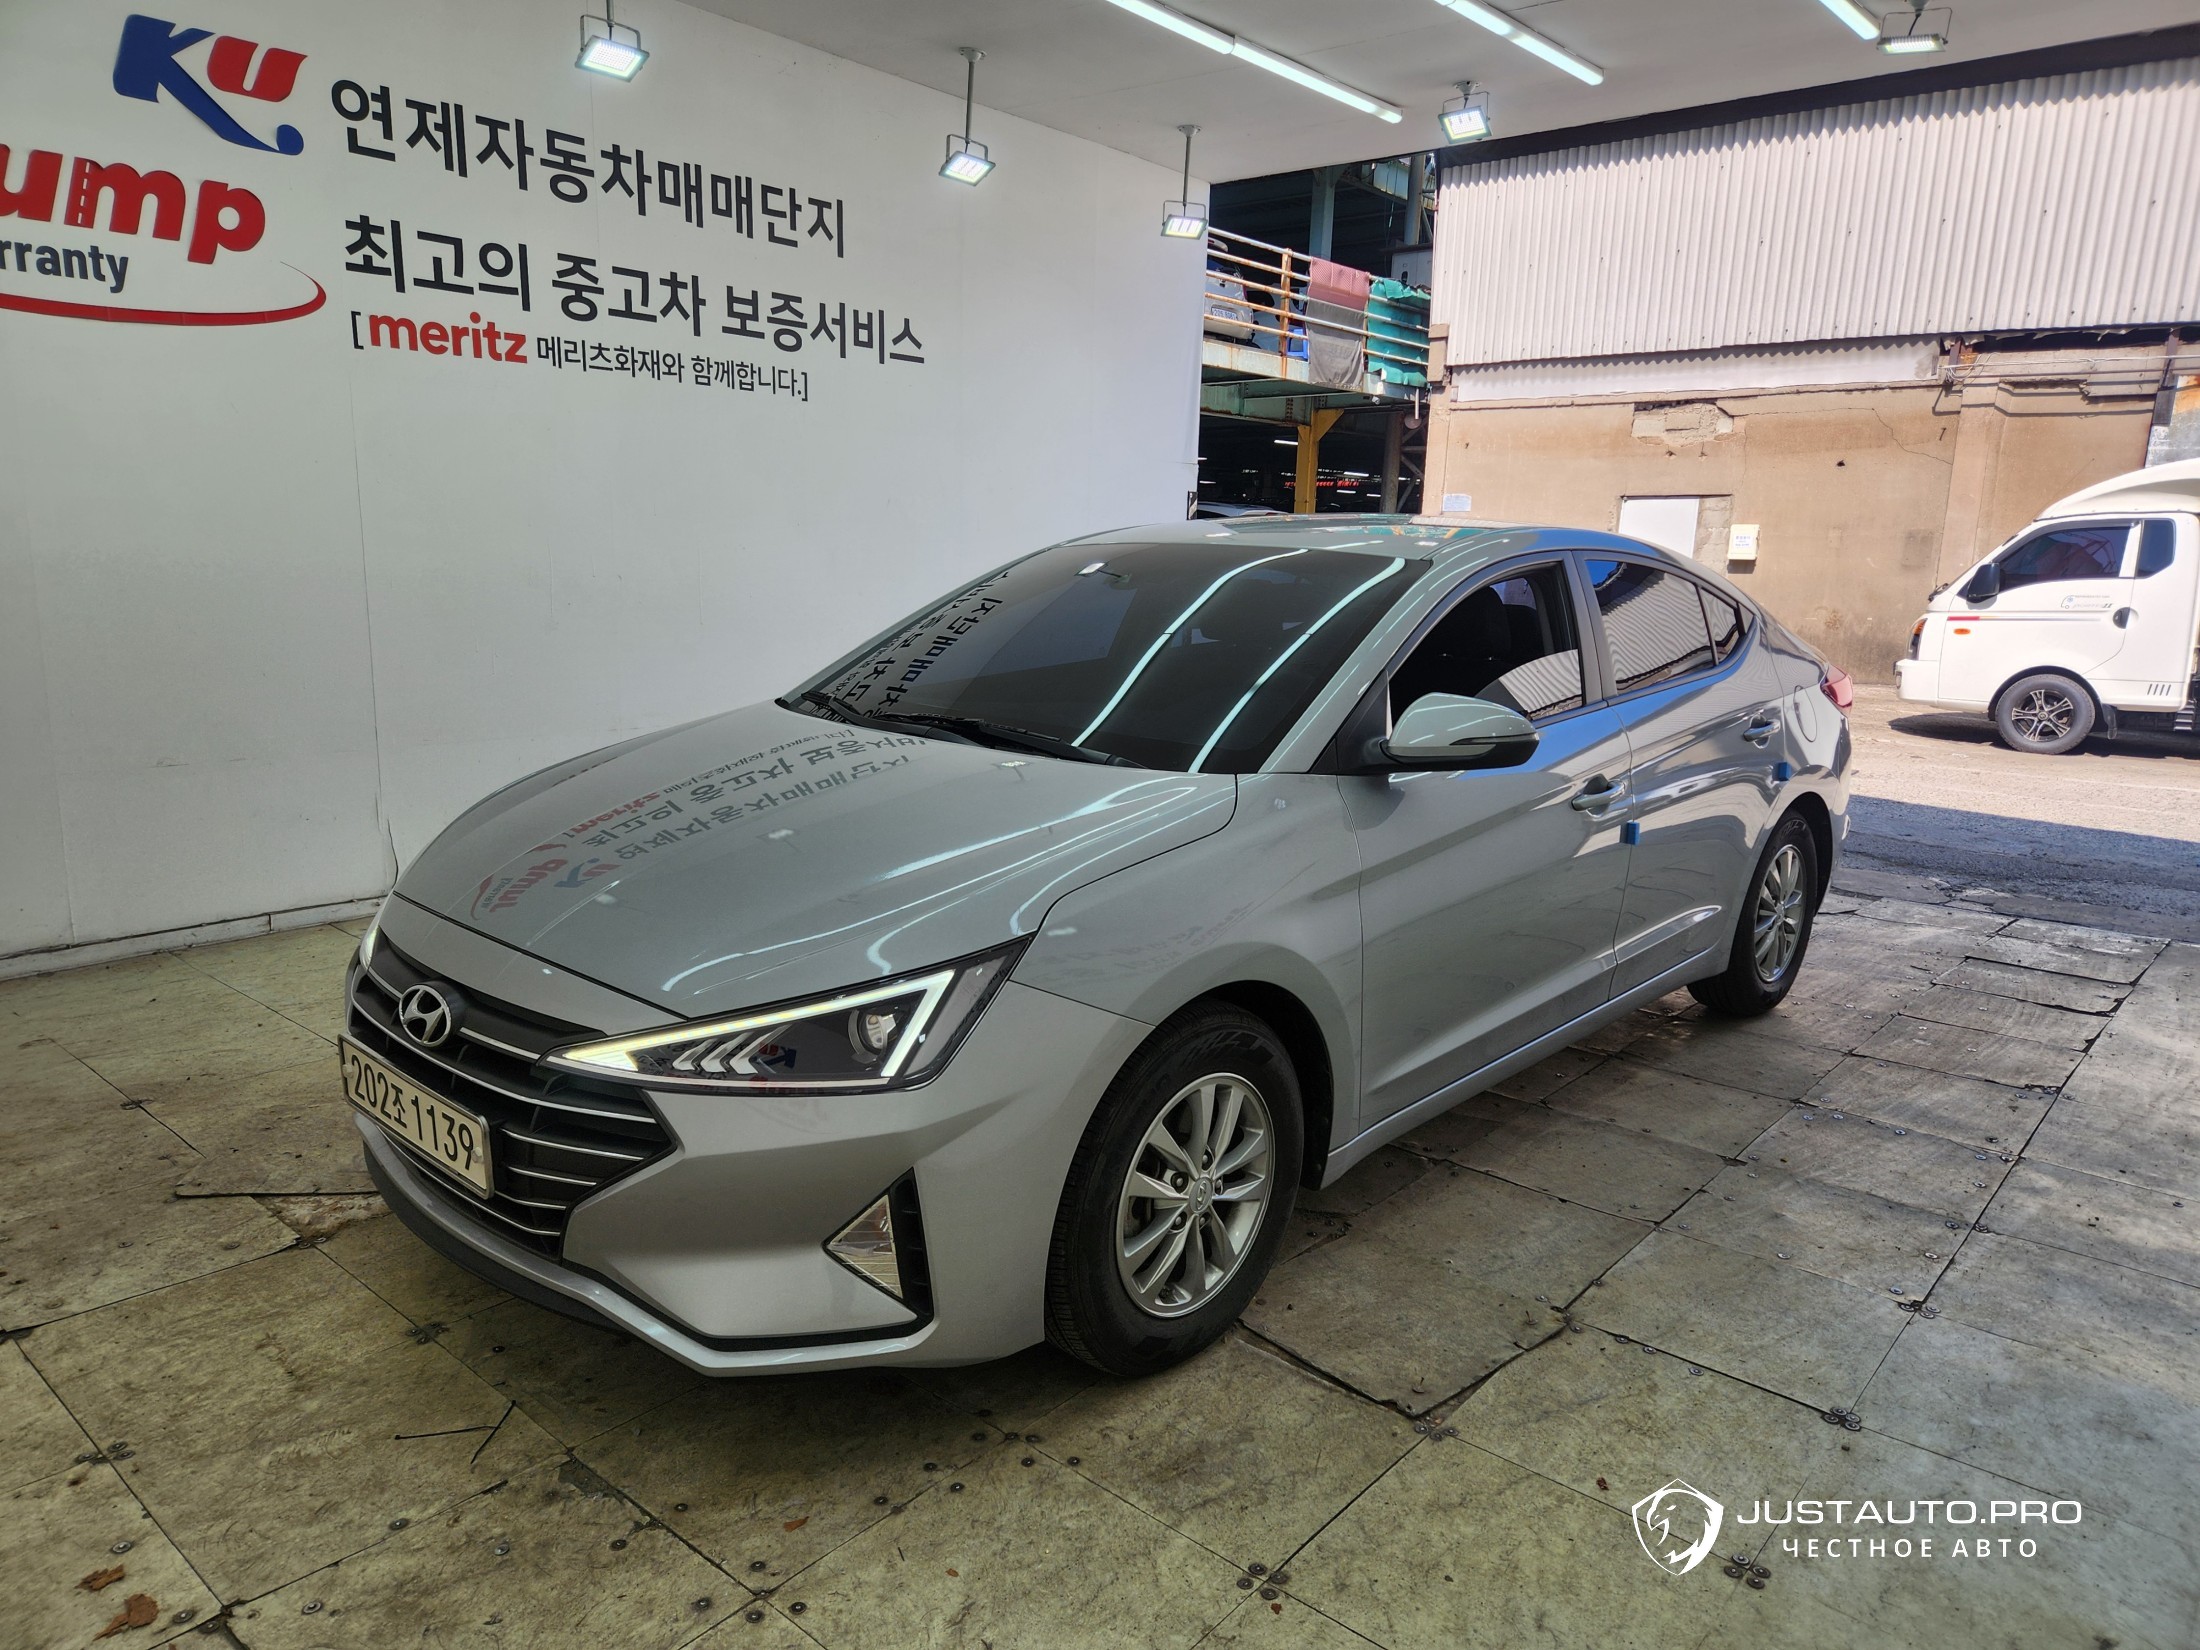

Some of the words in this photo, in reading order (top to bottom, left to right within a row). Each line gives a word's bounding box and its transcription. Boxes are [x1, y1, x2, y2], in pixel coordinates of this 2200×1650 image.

[331, 79, 845, 258] 연제자동차매매단지
[0, 239, 129, 294] rranty
[345, 215, 531, 312] 최고의
[552, 252, 706, 337] 중고차
[721, 285, 925, 365] 보증서비스
[537, 336, 685, 383] 메리츠화재와
